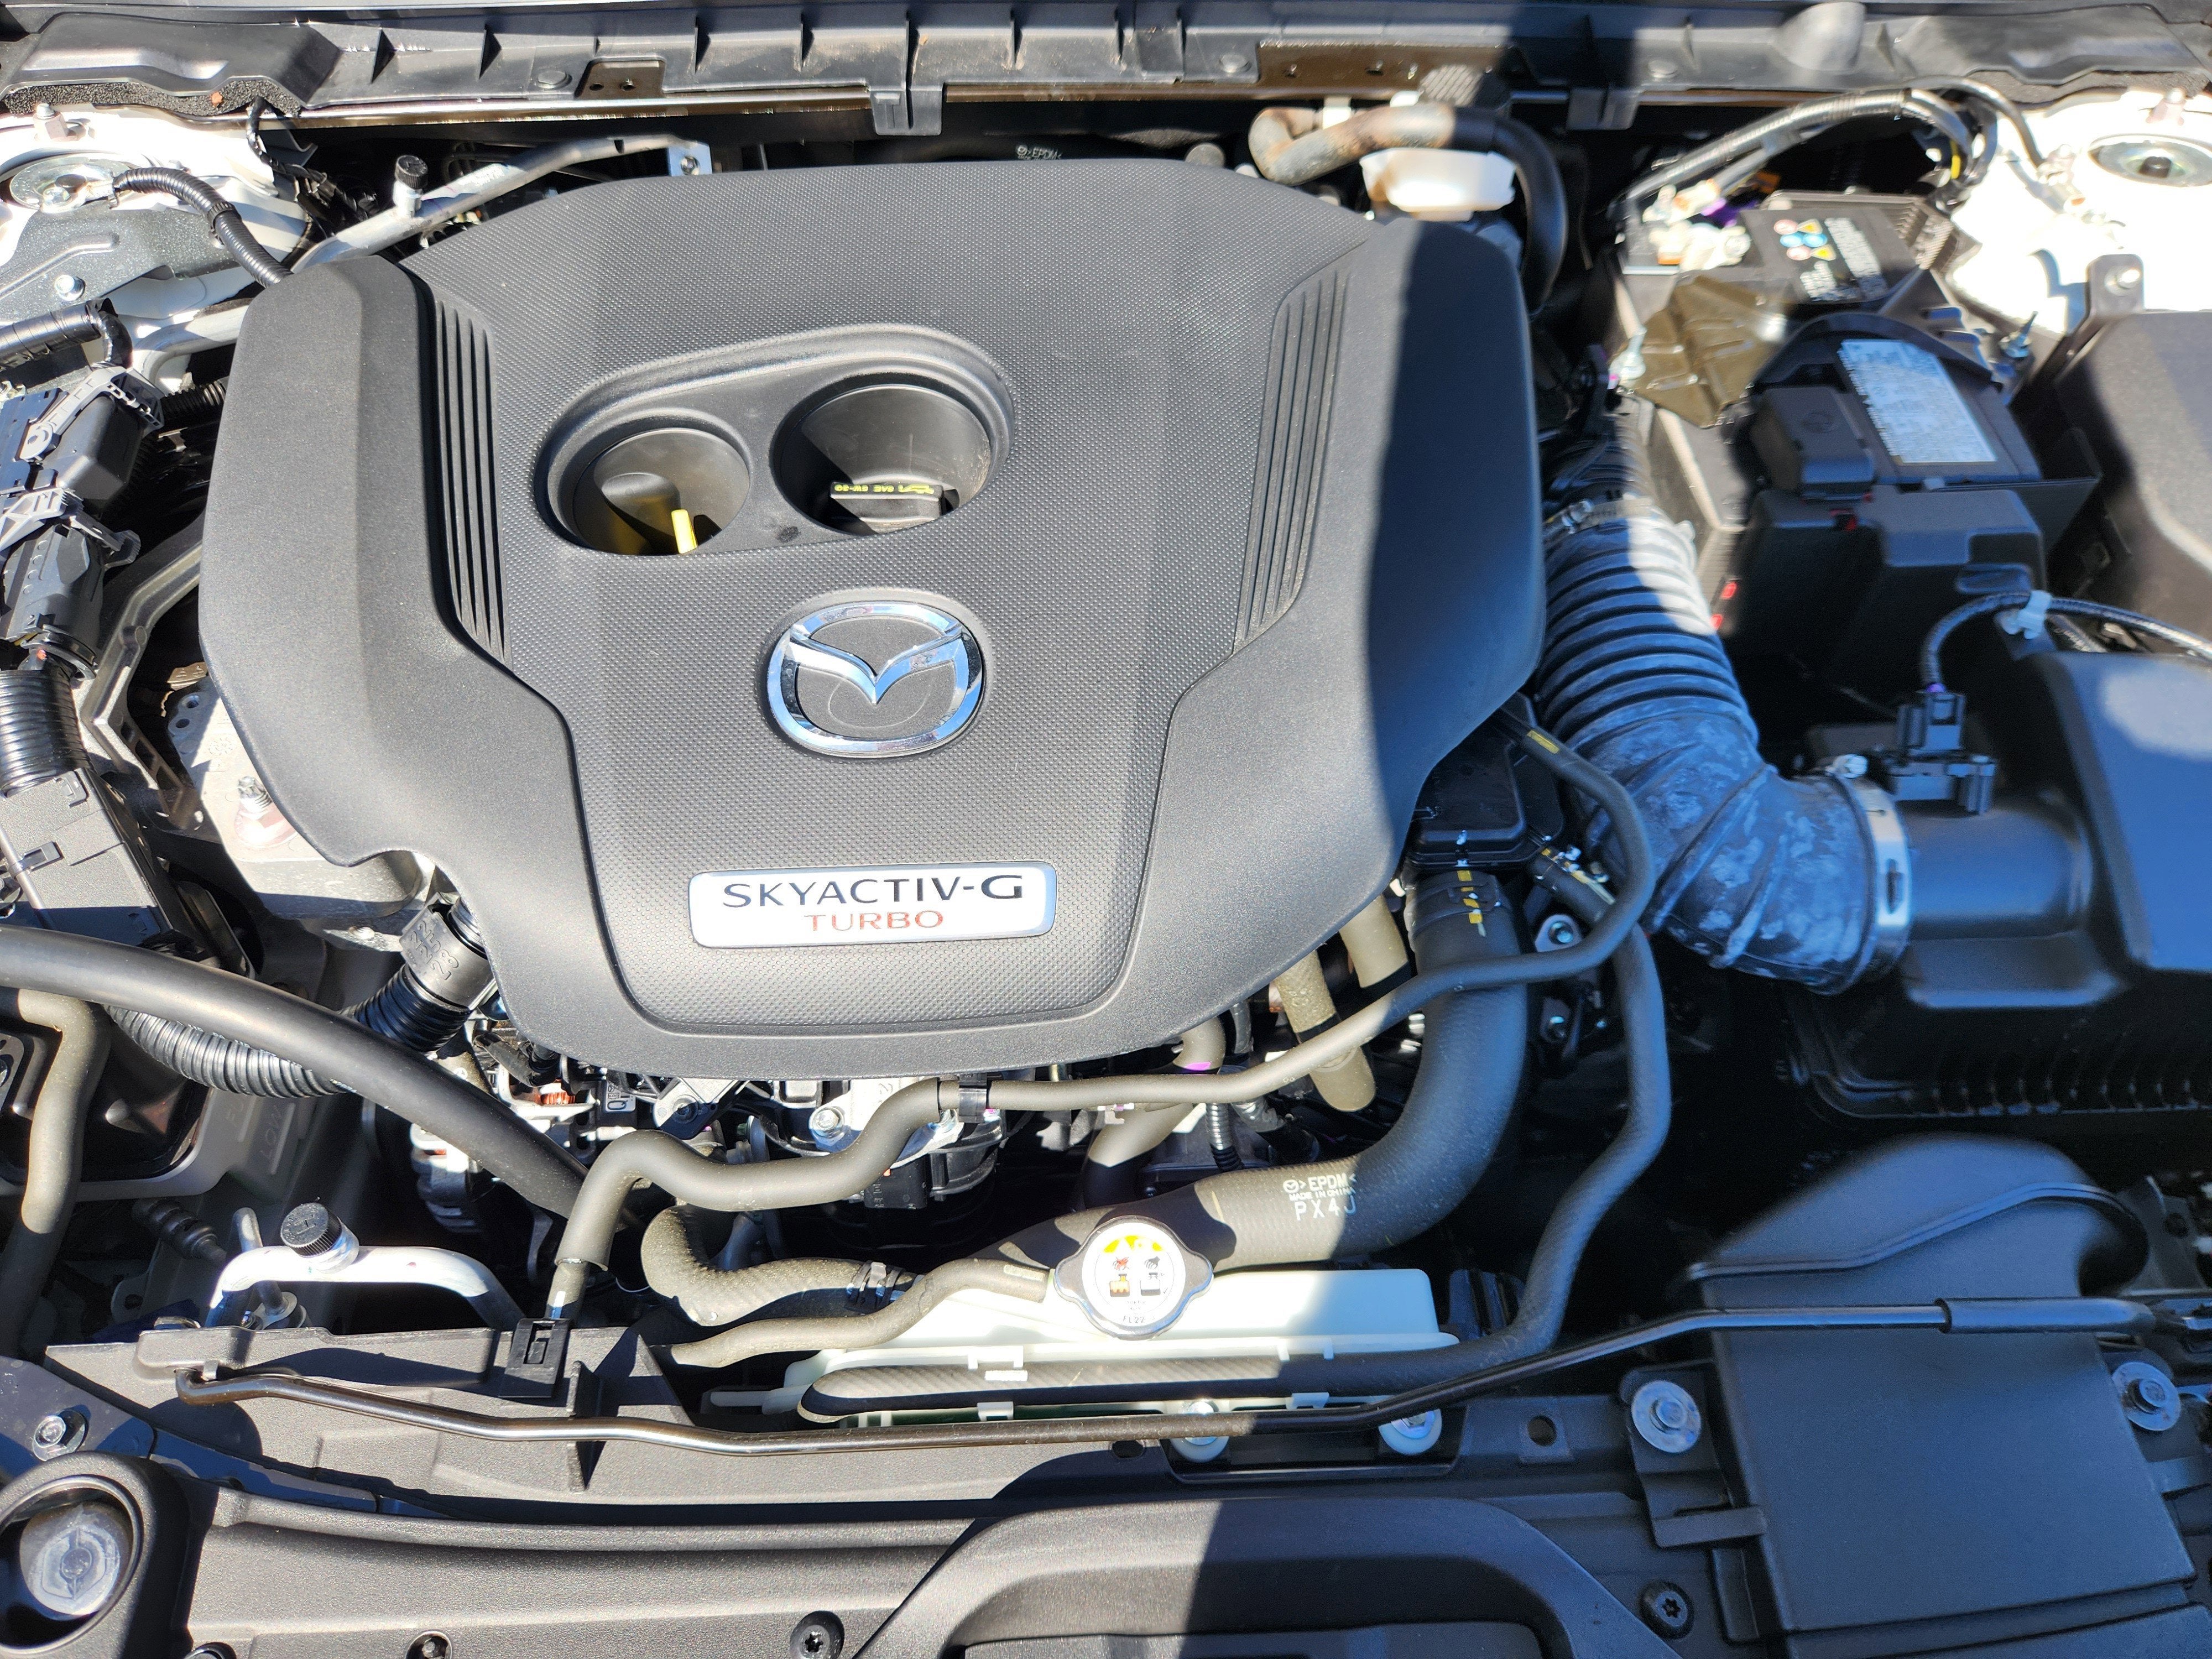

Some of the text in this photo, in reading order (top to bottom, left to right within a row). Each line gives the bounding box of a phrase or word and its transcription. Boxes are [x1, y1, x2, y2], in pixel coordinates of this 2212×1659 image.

[873, 484, 895, 493] SAE
[723, 874, 1022, 907] SKYACTIV-G
[410, 920, 432, 951] 22
[804, 910, 943, 931] TURBO
[420, 933, 441, 964] 25
[431, 949, 459, 980] 28
[1288, 1186, 1357, 1201] MADE IN CHINA
